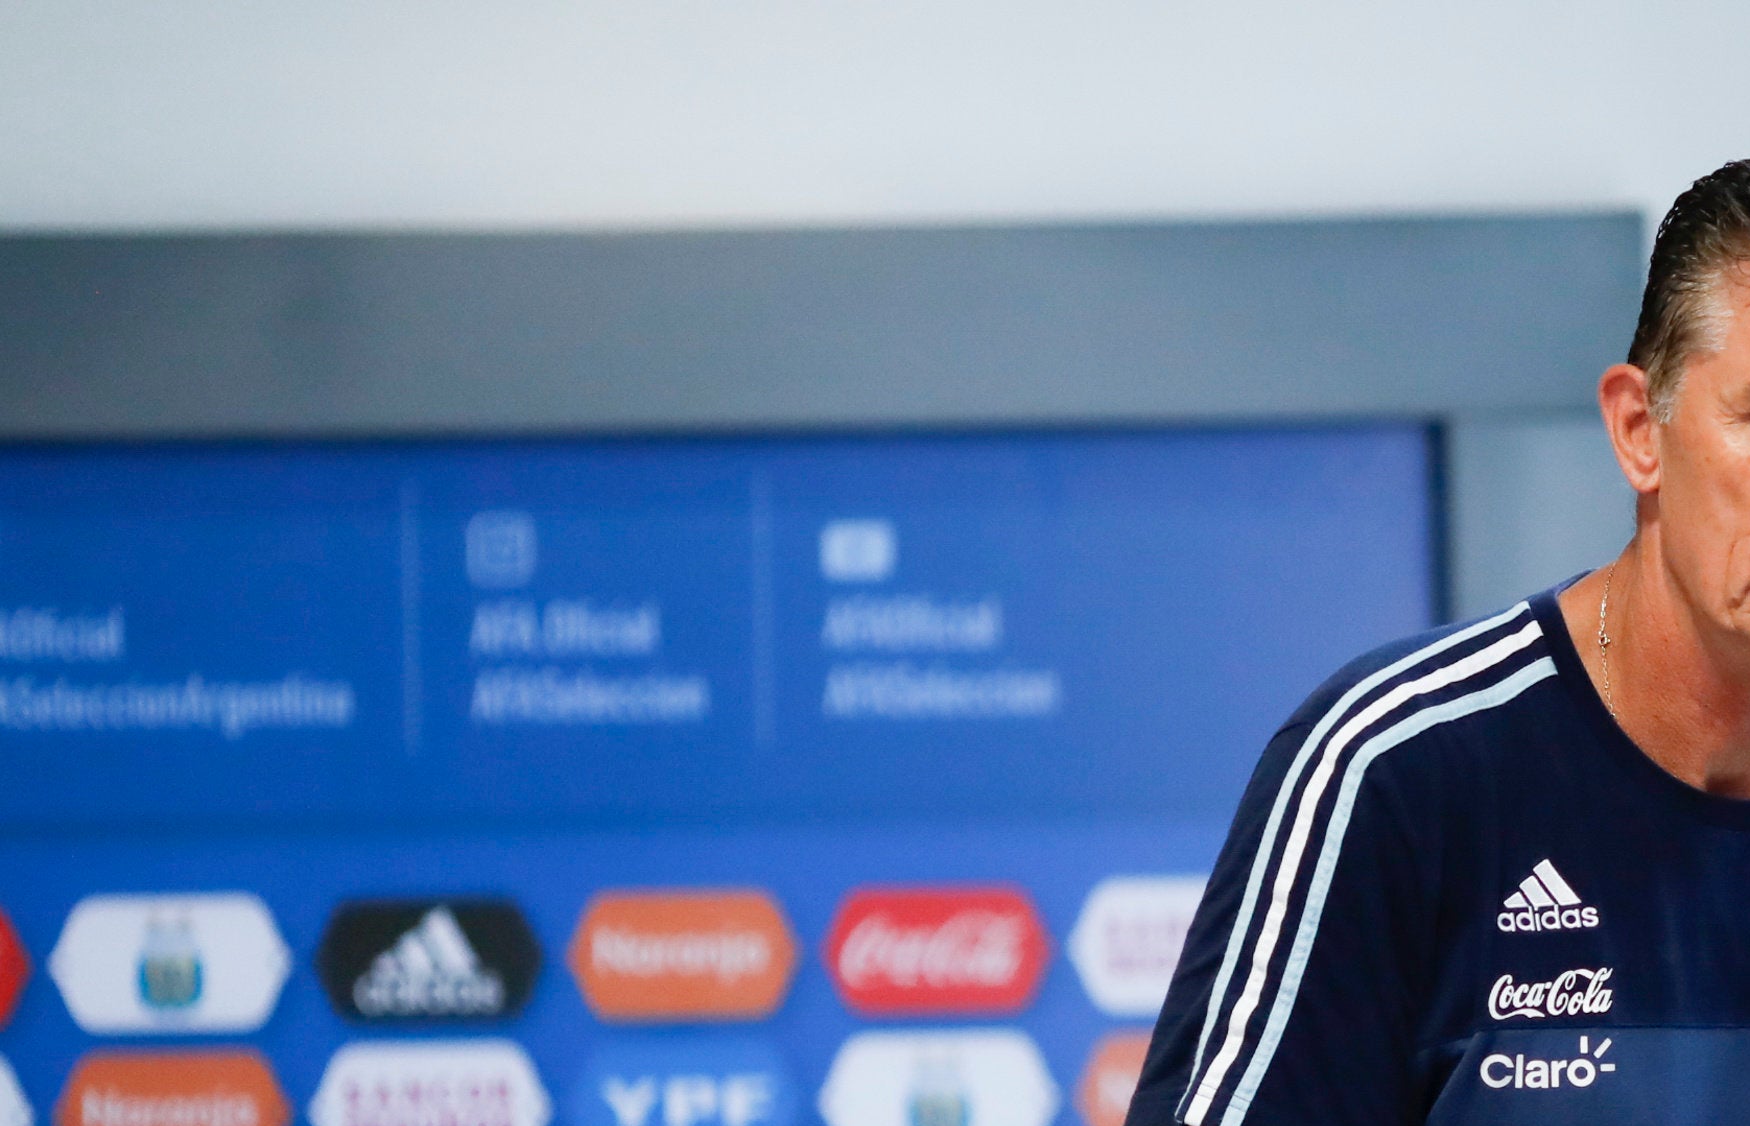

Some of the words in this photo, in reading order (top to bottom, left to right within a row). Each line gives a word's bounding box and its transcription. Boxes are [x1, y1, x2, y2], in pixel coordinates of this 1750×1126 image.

[1497, 902, 1599, 932] adidas
[1488, 967, 1613, 1020] Coca-Cola
[1480, 1053, 1596, 1089] Claro
